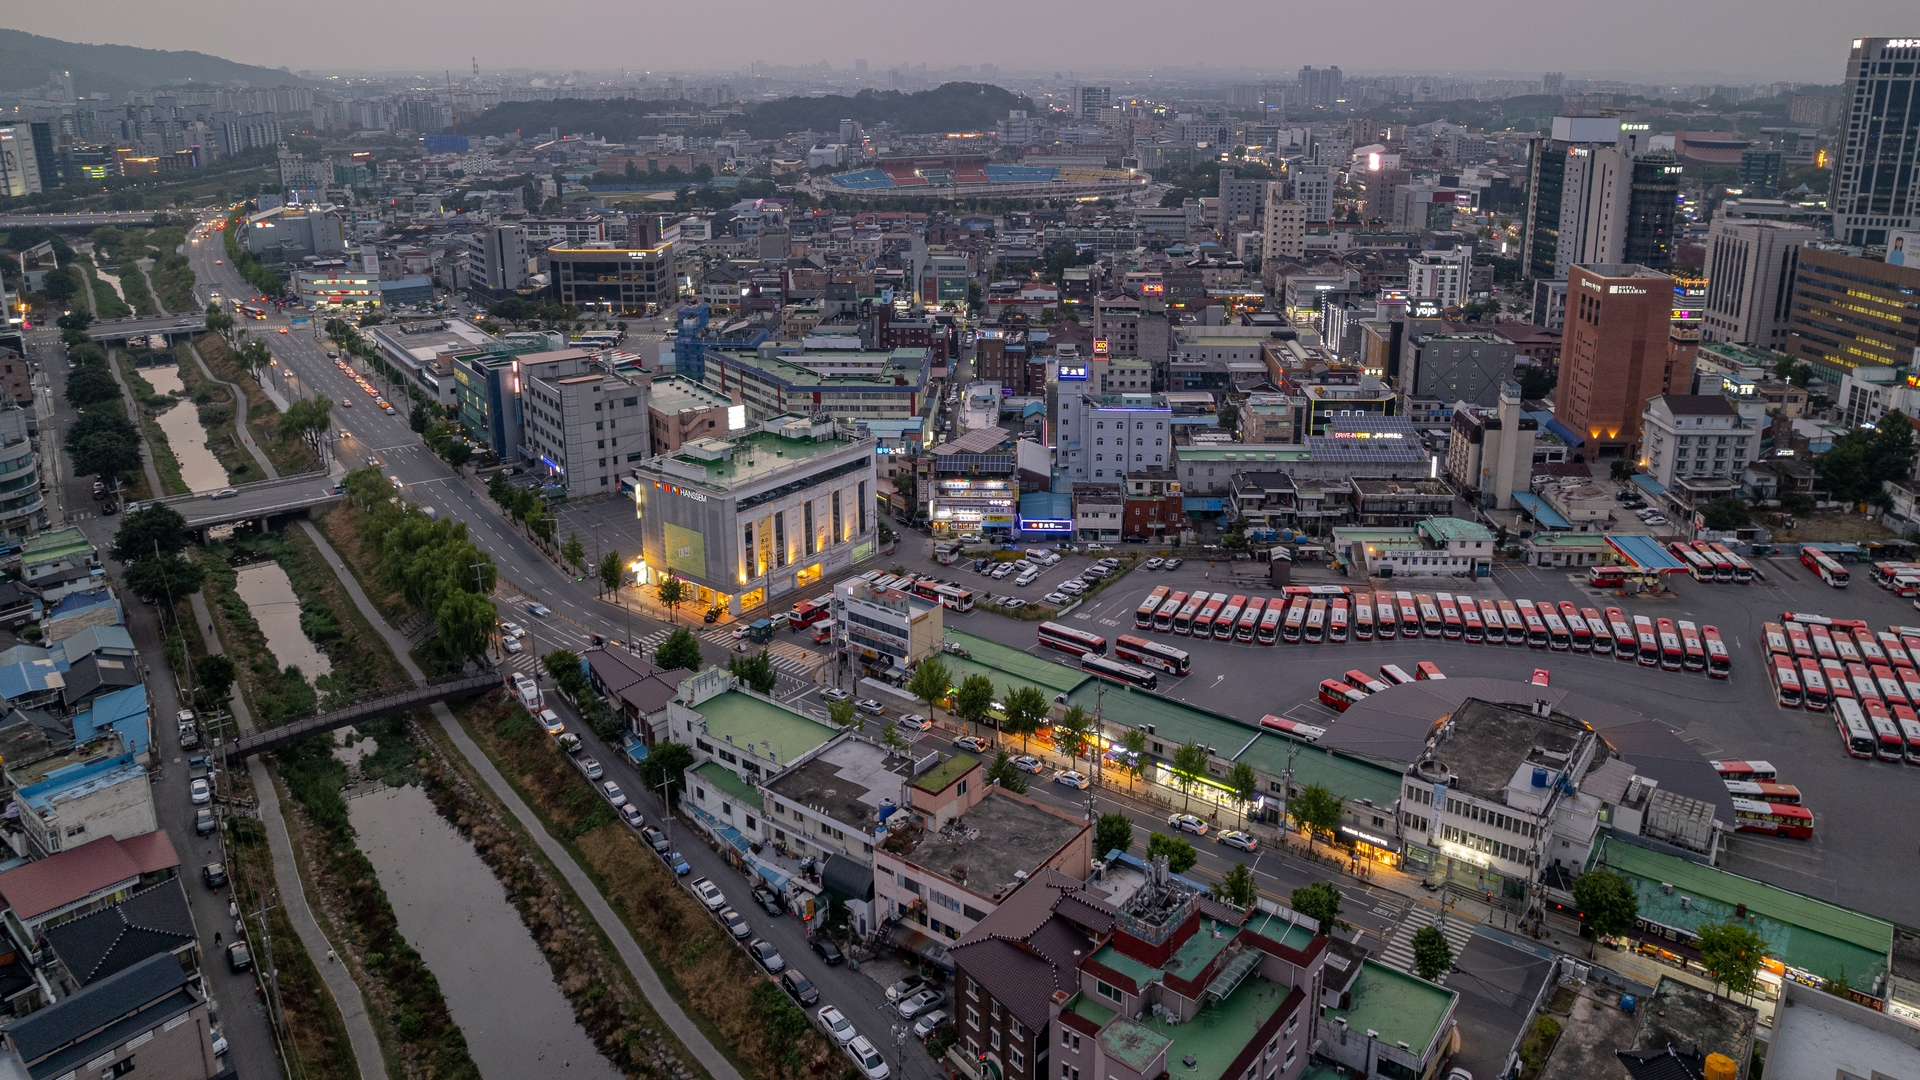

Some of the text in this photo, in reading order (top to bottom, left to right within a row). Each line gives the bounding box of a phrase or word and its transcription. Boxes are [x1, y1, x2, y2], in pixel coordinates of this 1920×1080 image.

[1416, 307, 1437, 317] yaja
[680, 490, 707, 503] HANSSEM
[1341, 825, 1388, 847] PARIS BAGUETTE
[1796, 976, 1815, 988] PC방
